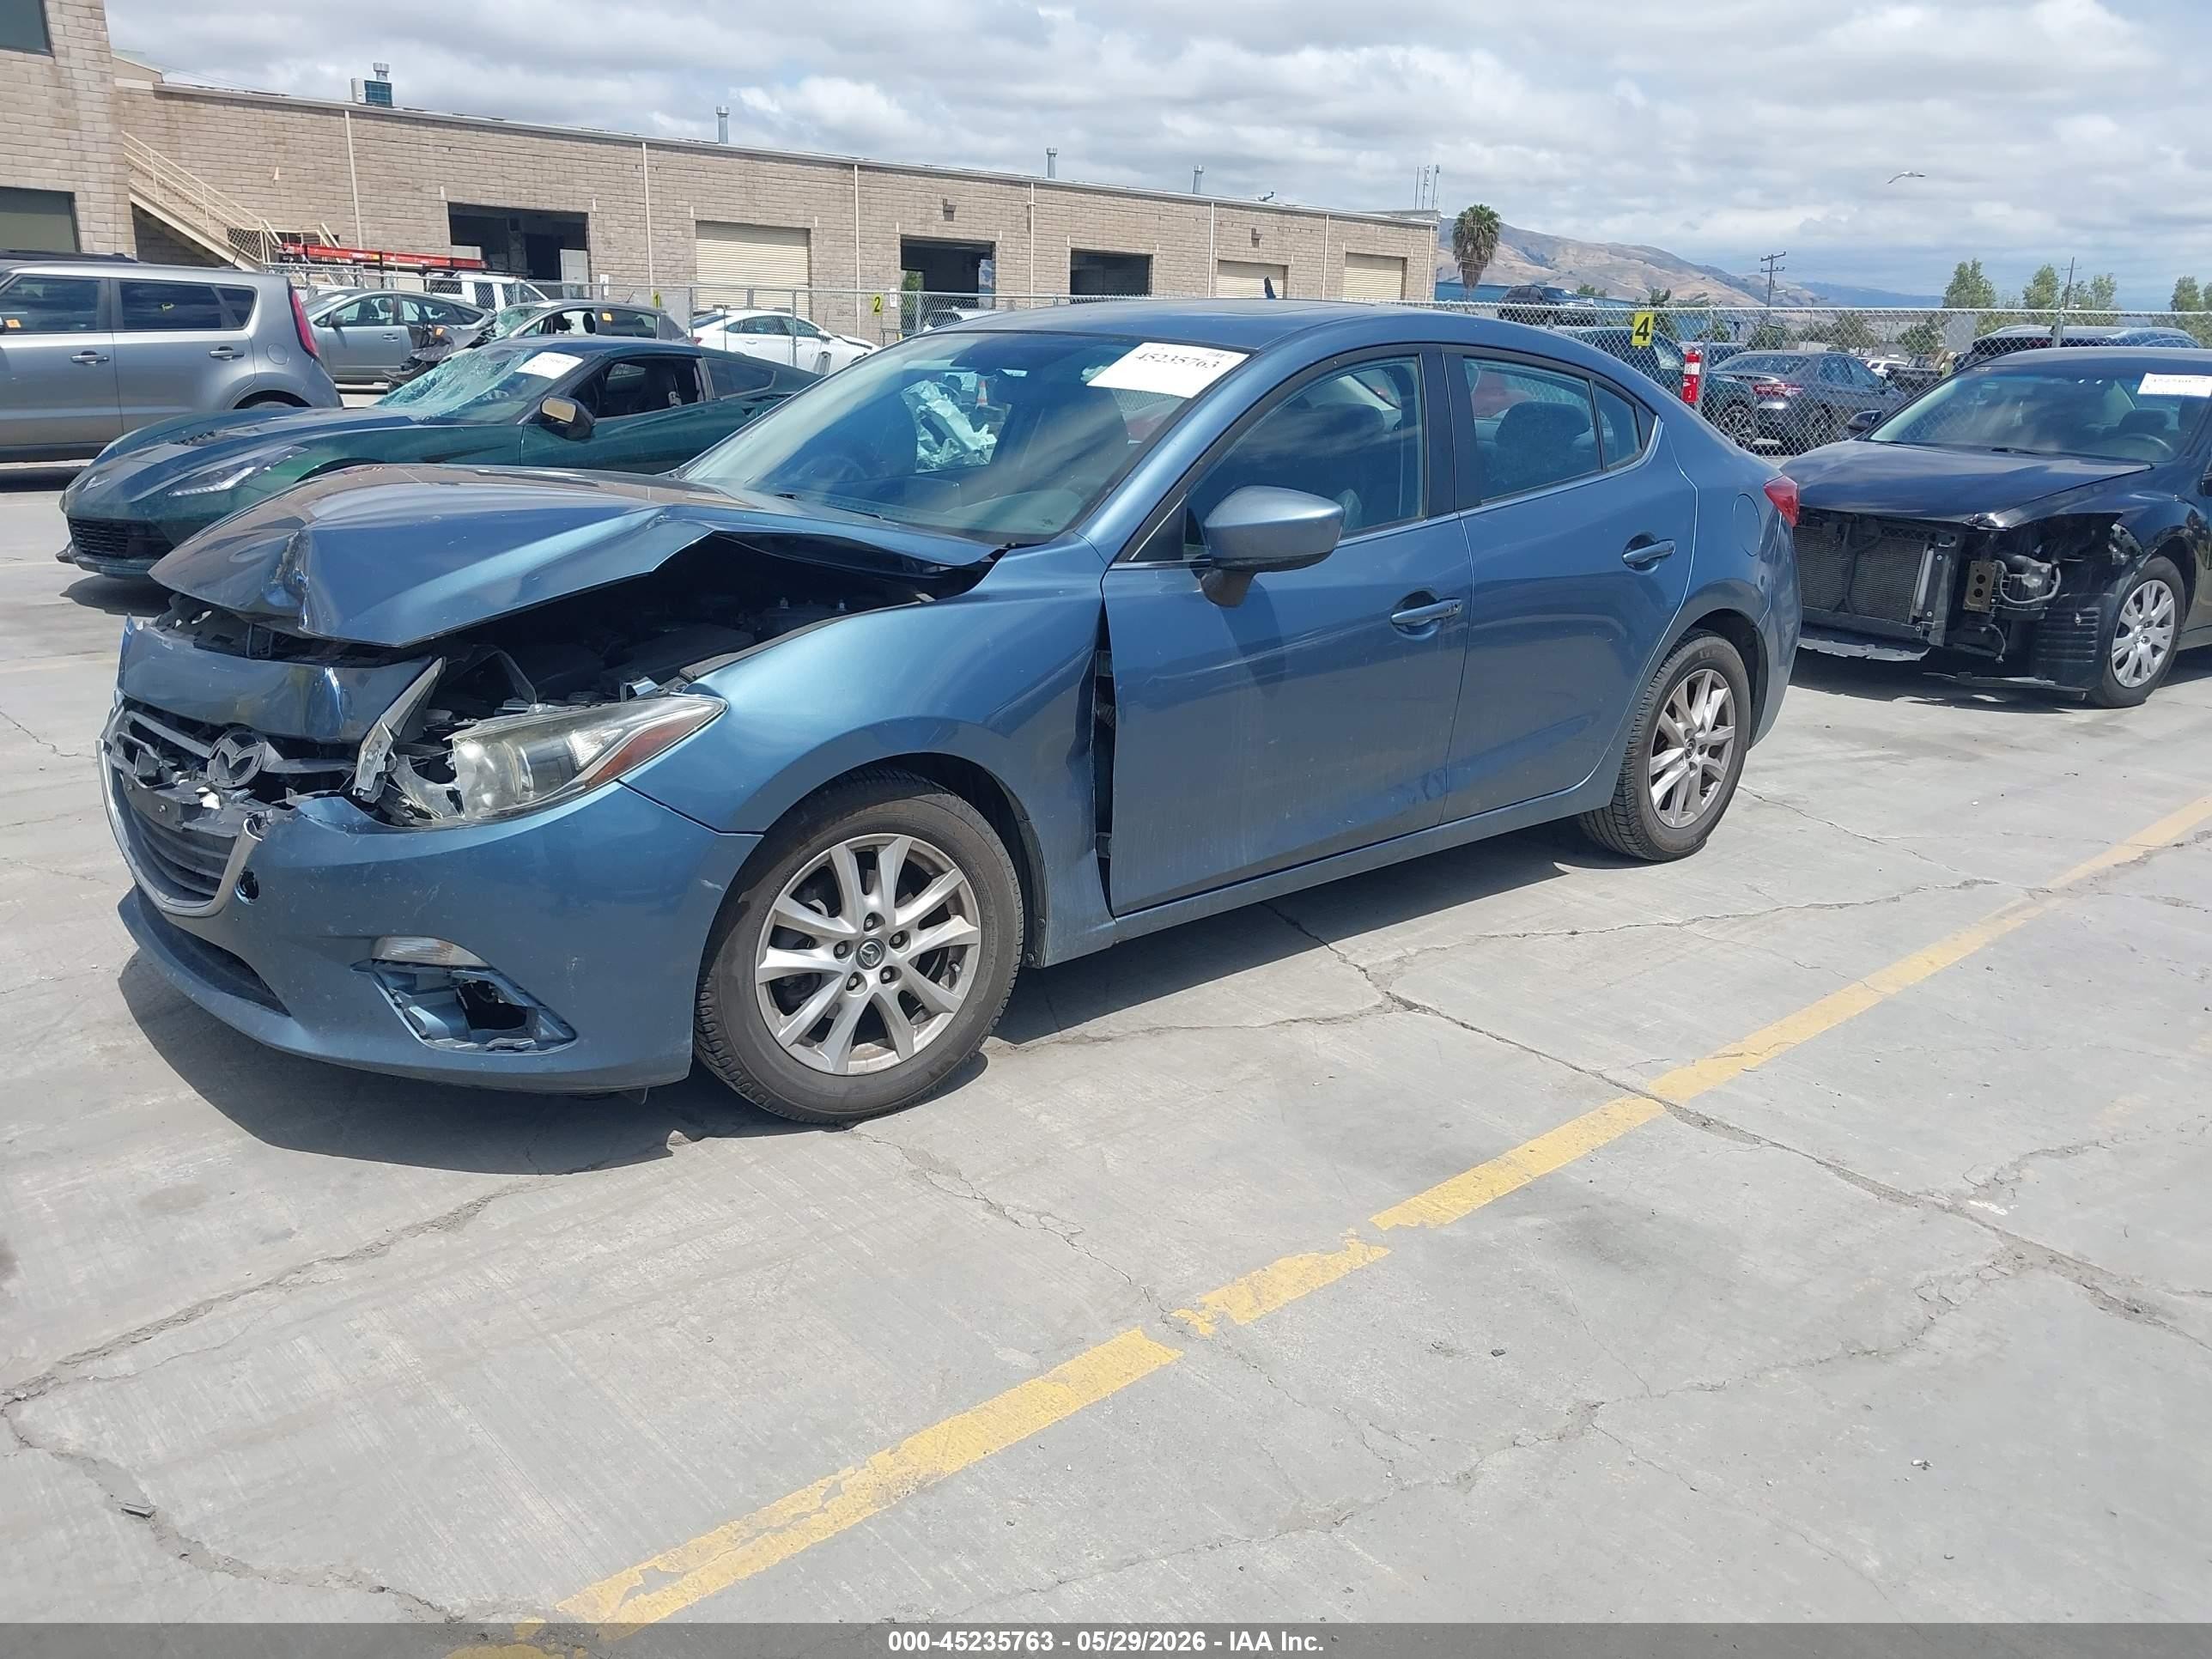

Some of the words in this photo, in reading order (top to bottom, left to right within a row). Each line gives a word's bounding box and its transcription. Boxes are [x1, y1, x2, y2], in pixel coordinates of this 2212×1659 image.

[873, 295, 880, 313] 2
[1635, 316, 1650, 341] 4
[1134, 352, 1220, 369] 45235763
